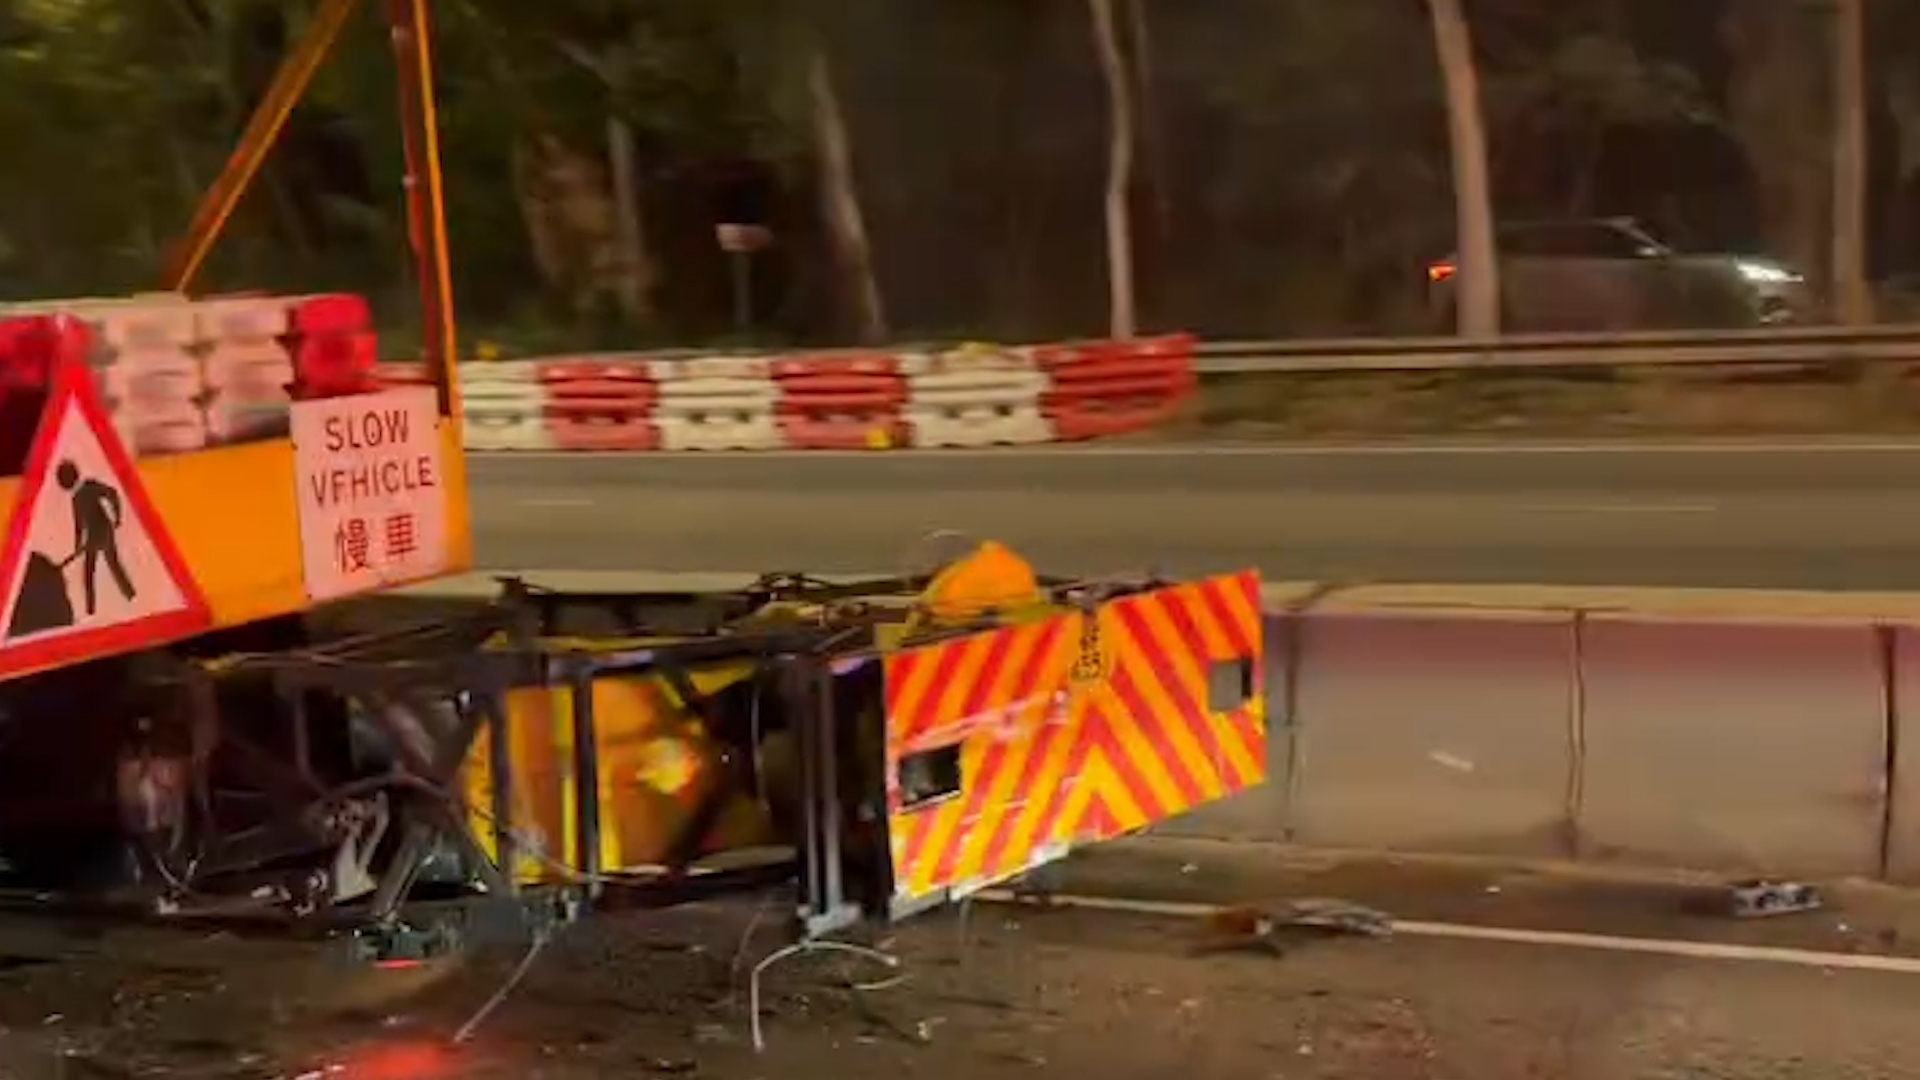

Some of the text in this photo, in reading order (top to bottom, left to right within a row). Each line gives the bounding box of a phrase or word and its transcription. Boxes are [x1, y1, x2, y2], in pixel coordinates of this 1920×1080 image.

[325, 410, 409, 451] SLOW
[311, 455, 434, 506] VEHICLE
[334, 514, 419, 573] 慢車
